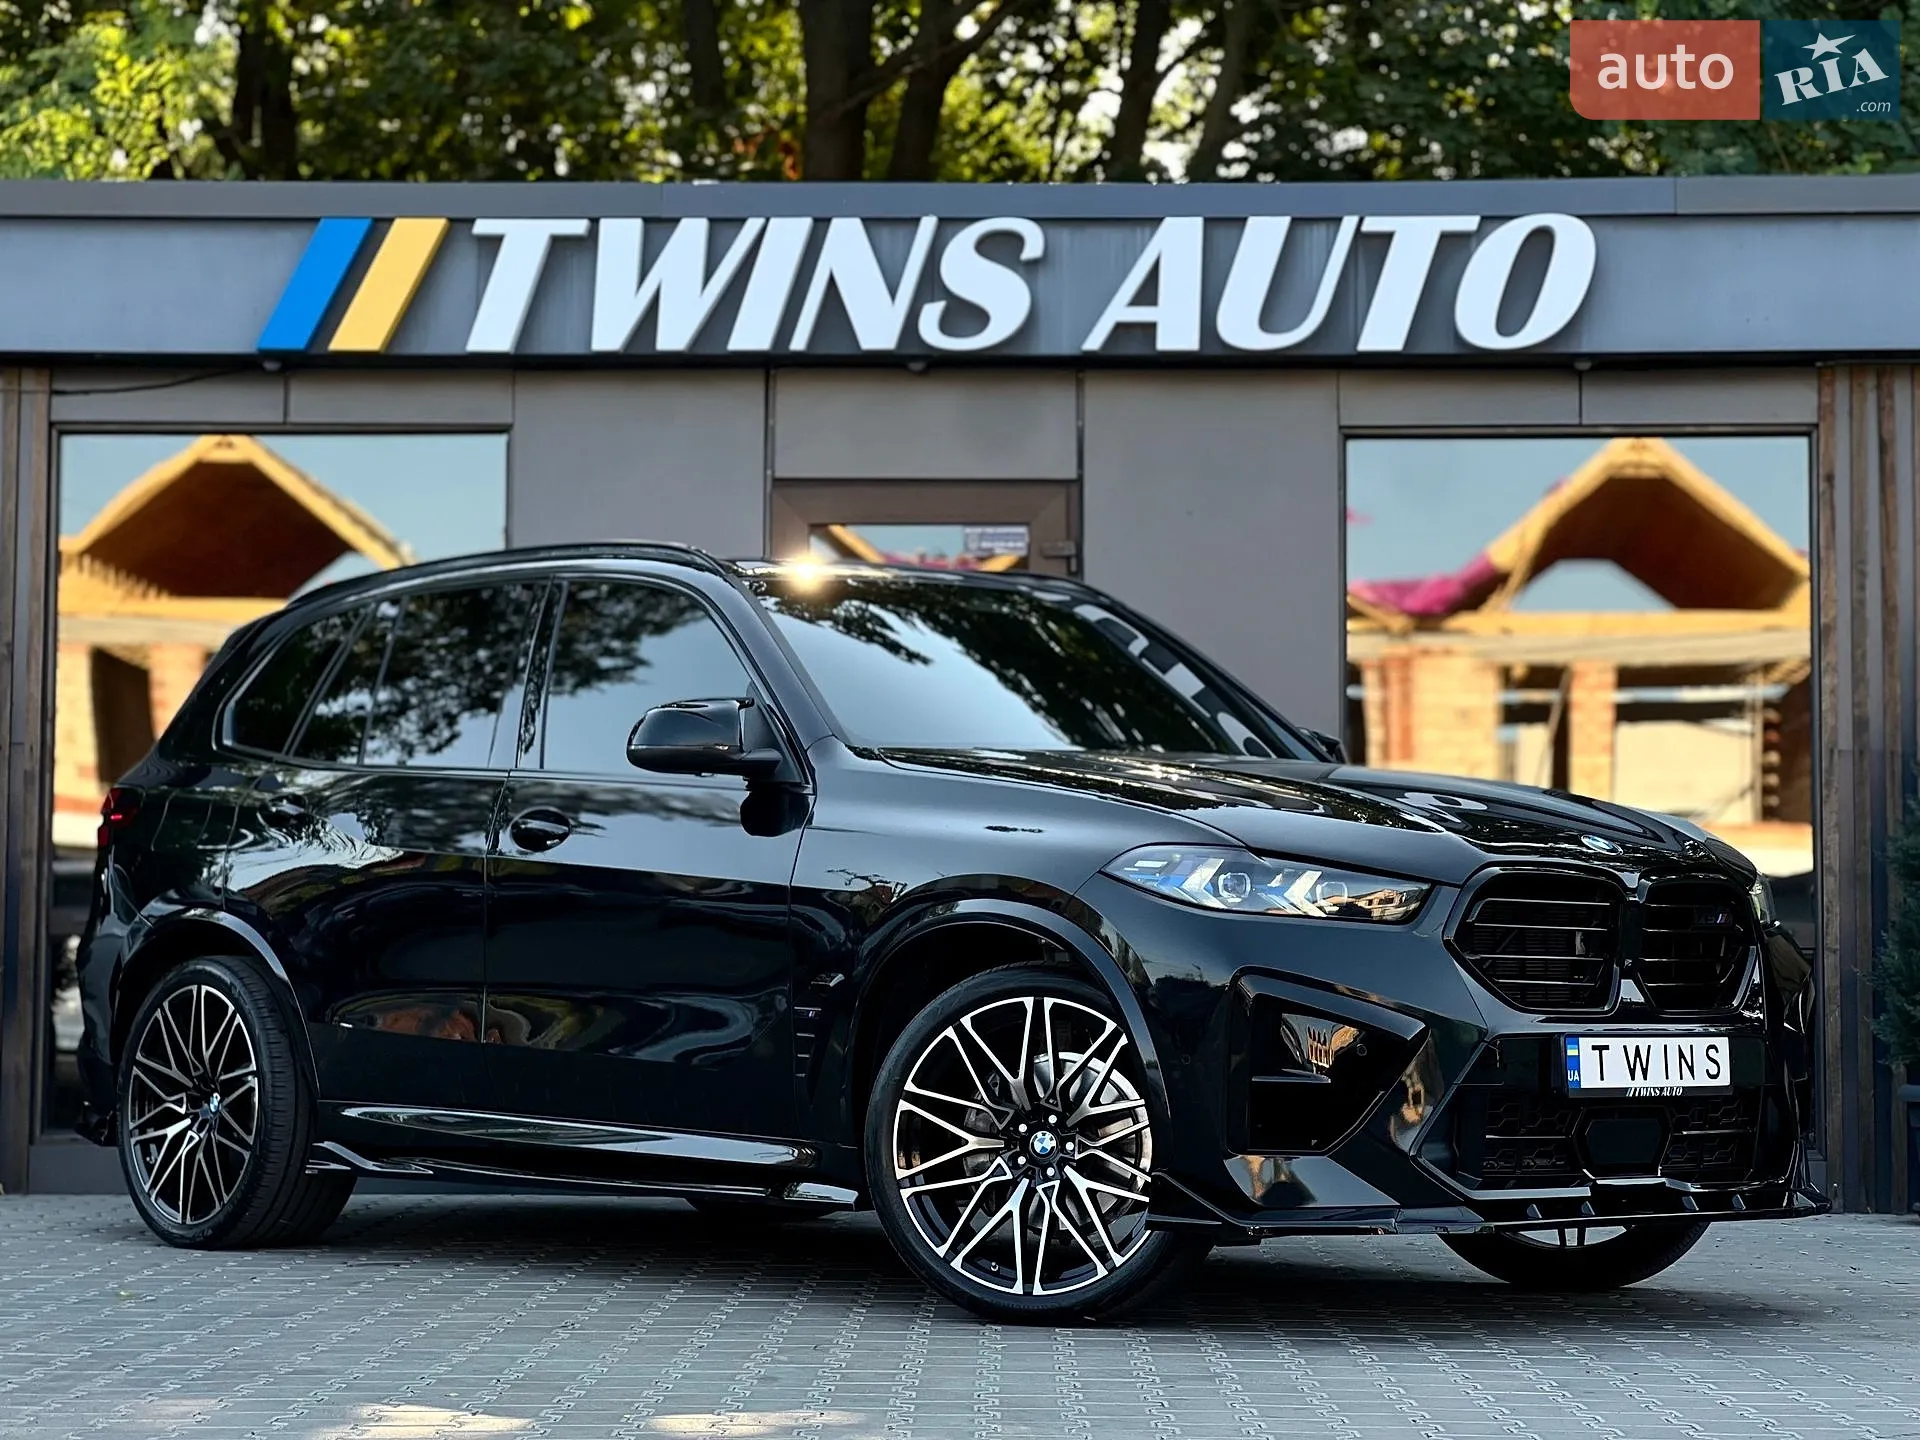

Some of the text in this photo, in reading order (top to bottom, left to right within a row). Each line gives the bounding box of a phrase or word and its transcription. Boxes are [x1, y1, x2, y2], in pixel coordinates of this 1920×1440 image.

[465, 213, 1597, 353] TWINS AUTO
[1567, 1069, 1580, 1082] UA
